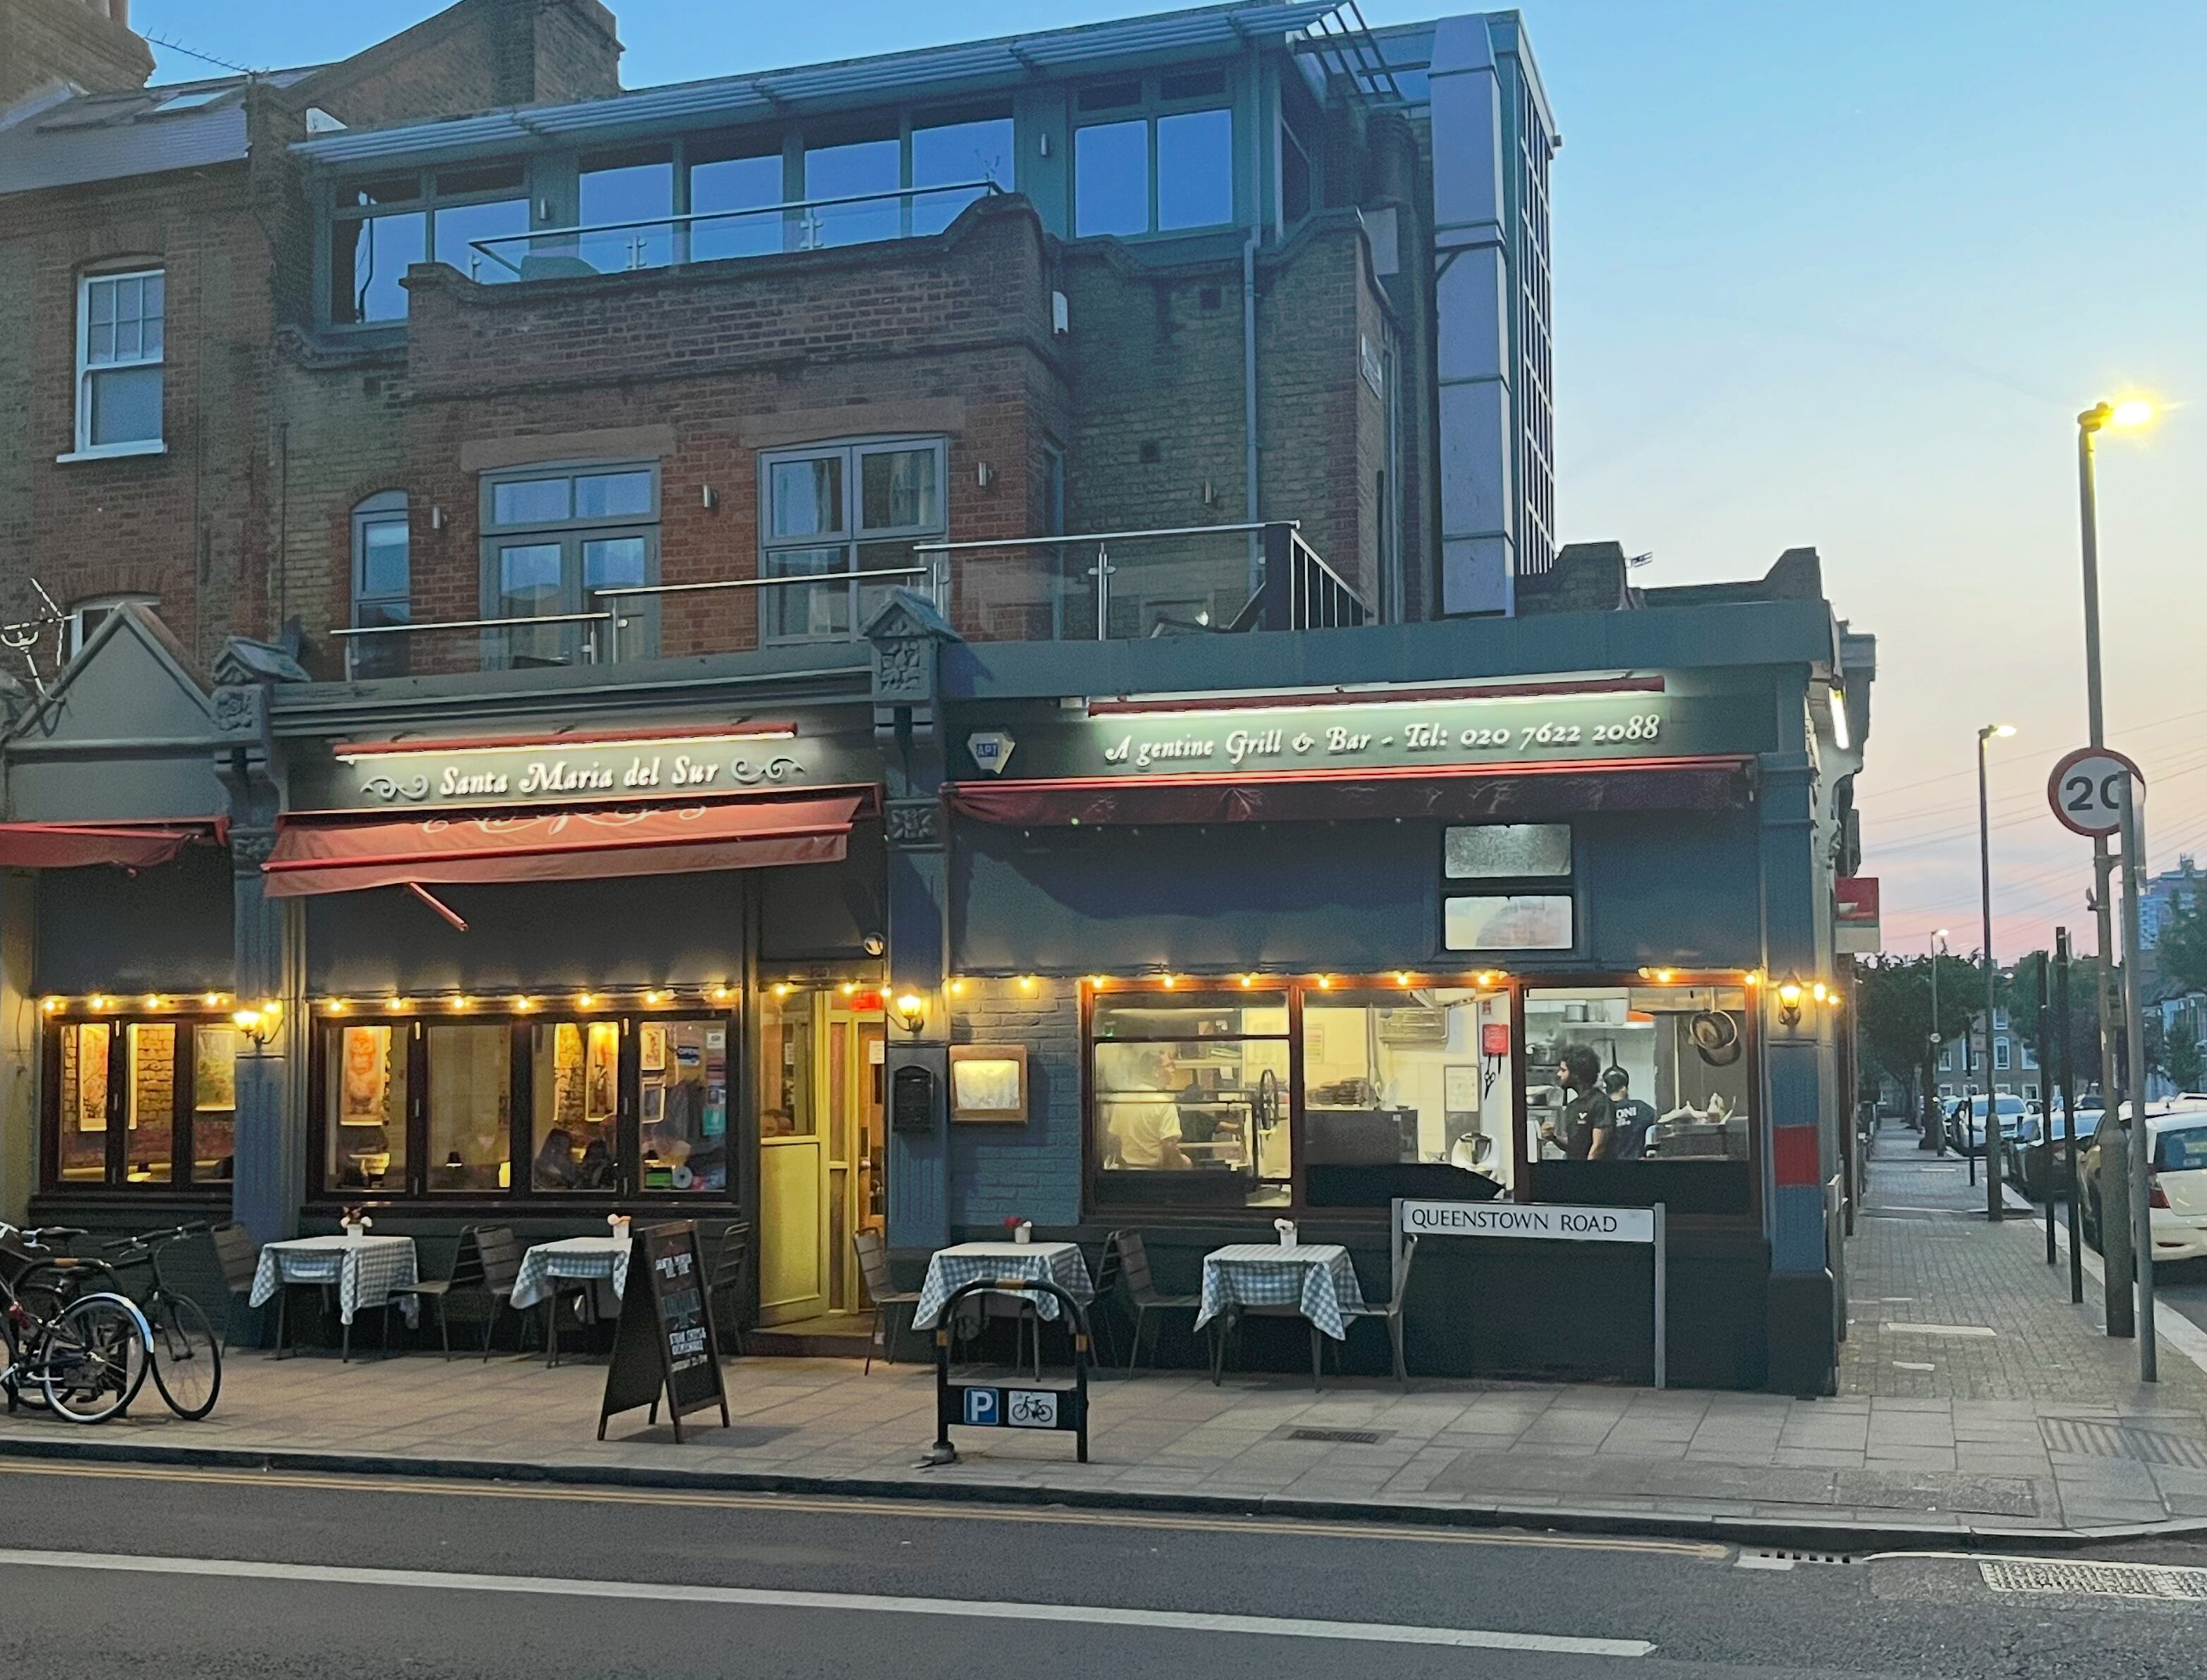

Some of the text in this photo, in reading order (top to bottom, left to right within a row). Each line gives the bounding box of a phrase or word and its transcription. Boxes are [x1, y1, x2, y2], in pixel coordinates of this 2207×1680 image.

[1225, 729, 1283, 765] Grill
[1291, 731, 1315, 753] &
[1325, 726, 1372, 751] Bar
[1404, 722, 1448, 747] Tel:
[1460, 728, 1510, 745] 020
[1519, 722, 1581, 751] 7622
[1591, 714, 1660, 740] 2088
[439, 755, 719, 796] Santa Maria del Sur
[1411, 1209, 1617, 1233] QUEENSTOWN ROAD
[971, 1391, 994, 1421] P
